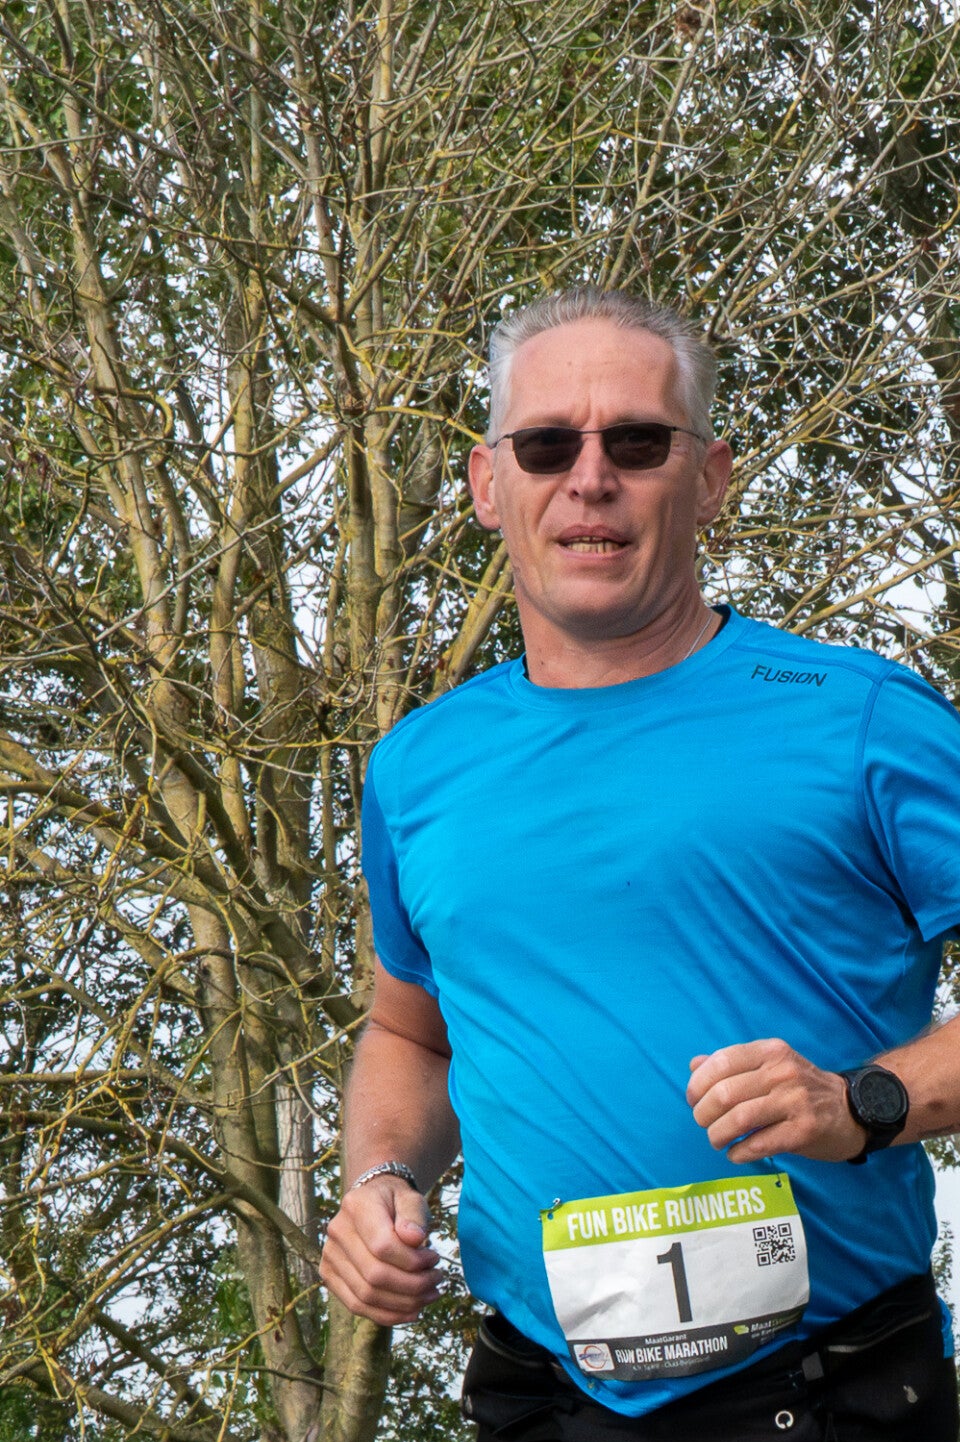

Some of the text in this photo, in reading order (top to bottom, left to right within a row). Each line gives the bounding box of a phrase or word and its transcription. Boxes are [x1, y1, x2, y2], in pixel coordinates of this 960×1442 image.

[751, 664, 828, 687] FUSION
[567, 1187, 766, 1241] FUN BIKE RUNNERS
[656, 1241, 693, 1323] 1
[614, 1349, 635, 1364] RUN
[636, 1346, 663, 1363] BIKE
[664, 1335, 728, 1361] MARATHON
